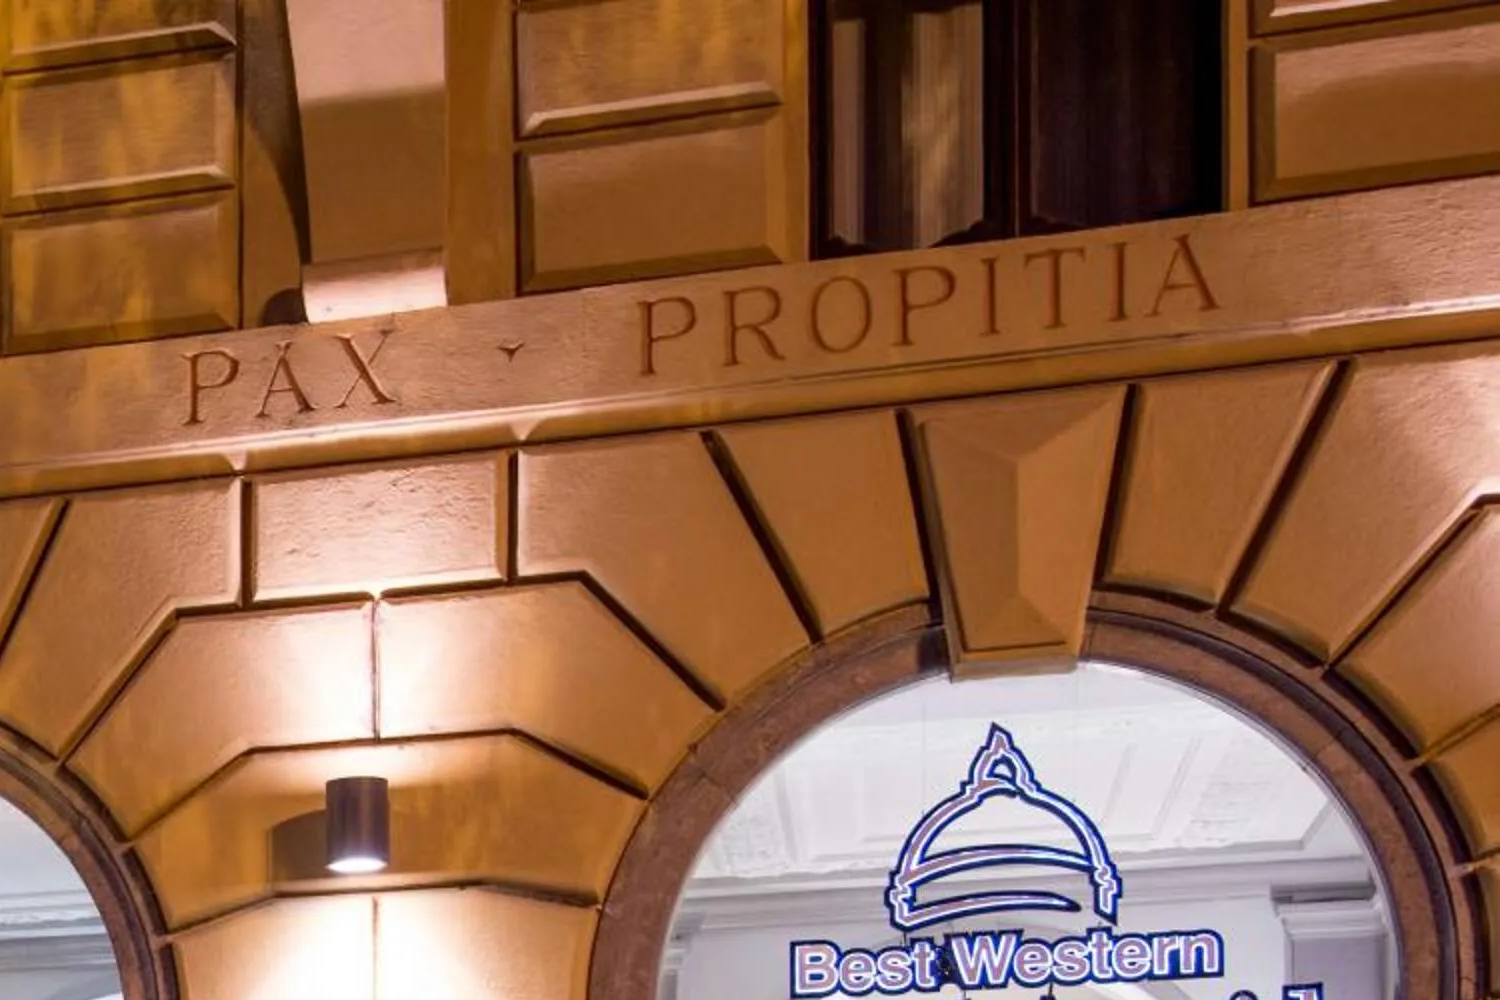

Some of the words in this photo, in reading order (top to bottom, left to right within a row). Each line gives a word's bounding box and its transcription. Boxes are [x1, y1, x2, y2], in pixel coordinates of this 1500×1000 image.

[180, 329, 396, 427] PAX
[637, 232, 1222, 377] PROPITIA
[791, 938, 937, 998] Best
[943, 926, 1224, 990] Western
